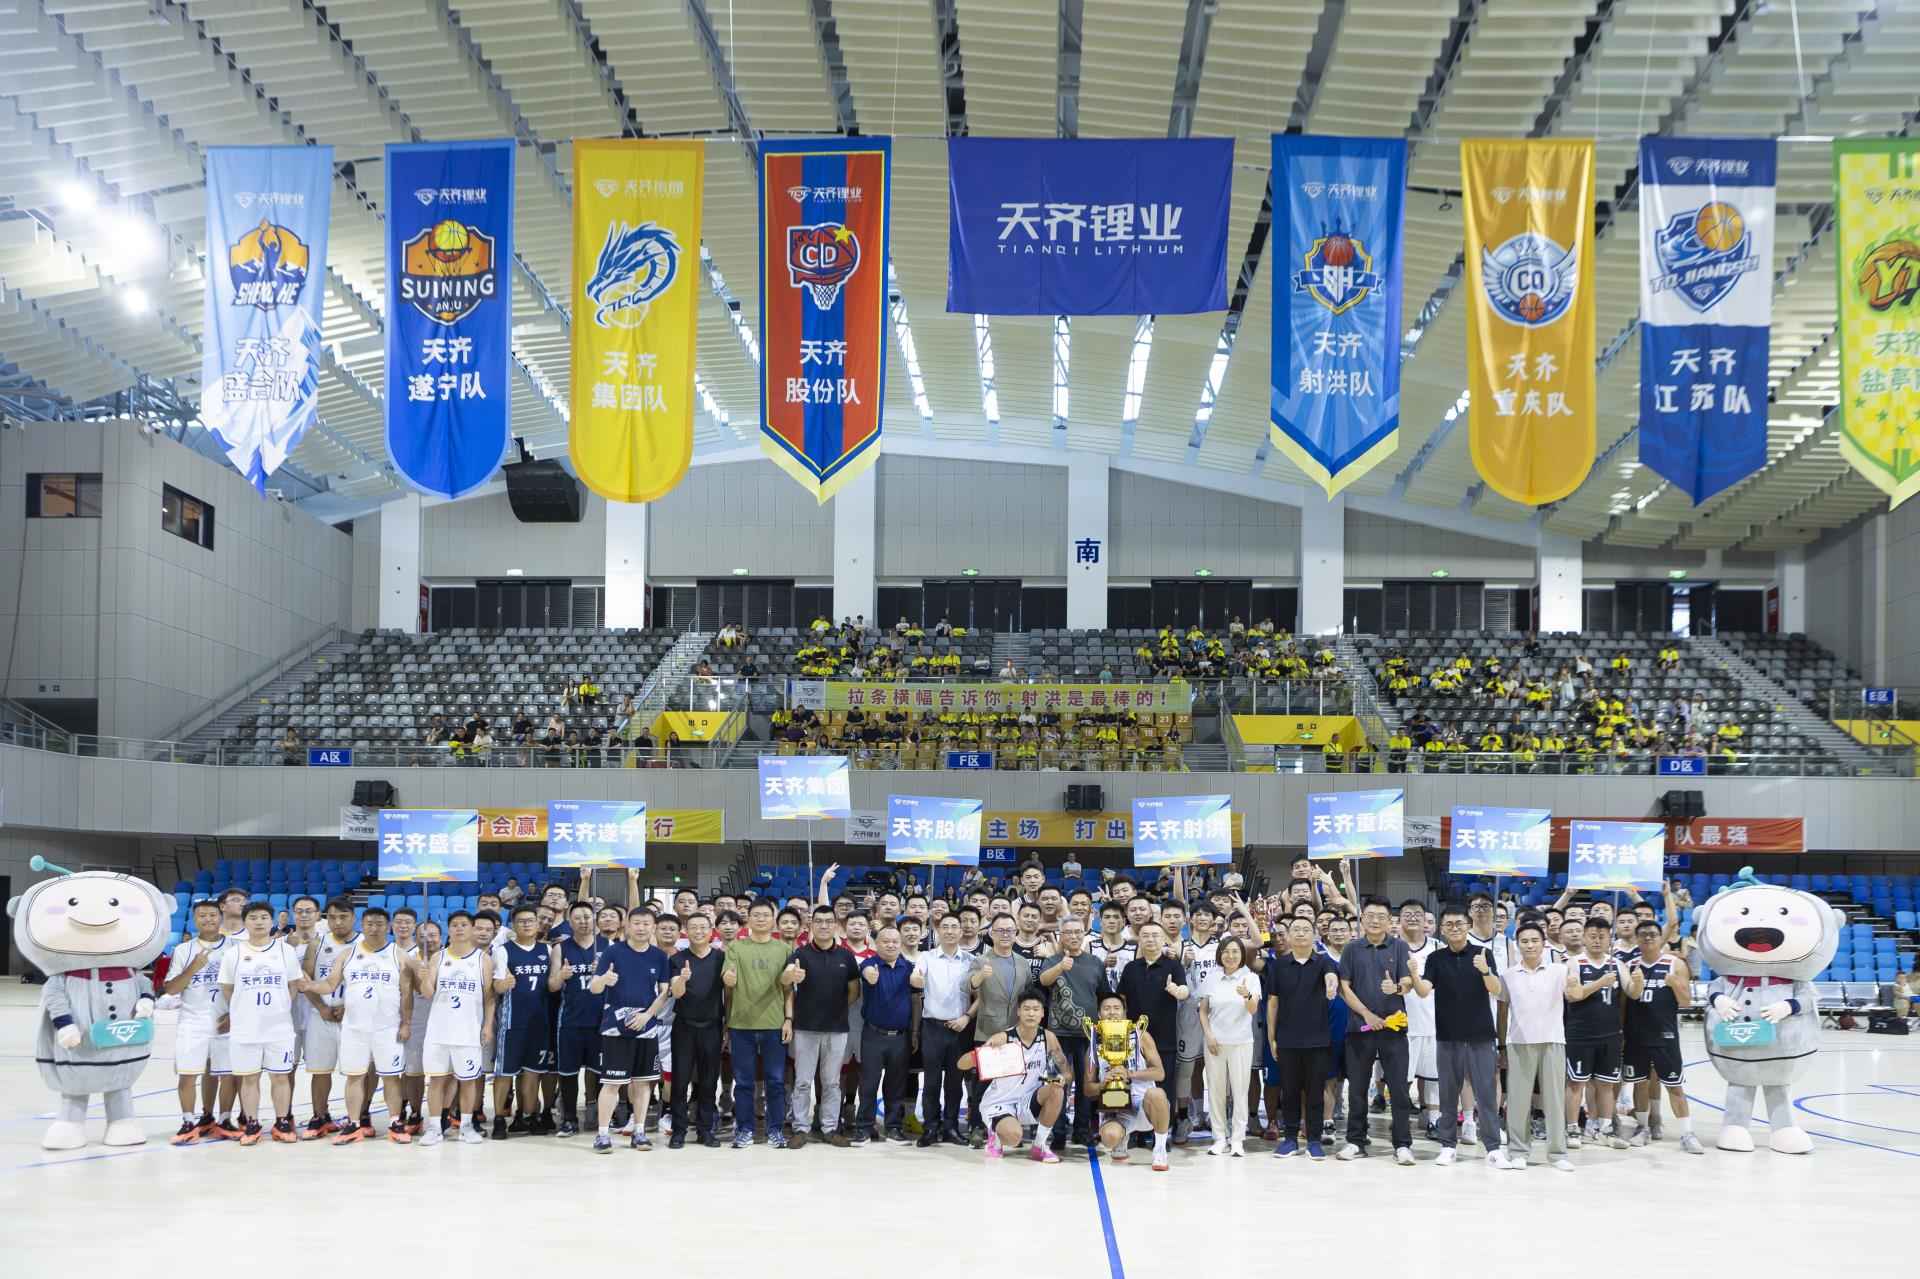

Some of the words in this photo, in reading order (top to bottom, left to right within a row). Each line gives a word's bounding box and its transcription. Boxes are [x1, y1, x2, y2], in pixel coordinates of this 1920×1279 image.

[996, 202, 1183, 242] 天齐锂业
[800, 243, 839, 267] CD
[997, 244, 1077, 256] TIANQI
[1095, 244, 1183, 256] LITHIUM
[236, 282, 276, 305] SHENG
[277, 281, 300, 304] HE
[401, 274, 494, 300] SUINING
[436, 301, 462, 313] ANJU
[234, 337, 290, 368] 天齐
[422, 337, 473, 365] 天齐
[800, 339, 848, 366] 天齐
[1313, 331, 1363, 358] 天齐
[602, 350, 658, 380] 天齐
[1506, 352, 1560, 382] 天齐
[1669, 347, 1737, 376] 天齐
[408, 371, 487, 402] 遂宁队
[785, 377, 861, 406] 股份队
[1299, 367, 1375, 398] 射洪队
[591, 381, 668, 413] 集团队
[1492, 388, 1575, 418] 重庆队
[1654, 383, 1753, 415] 江苏队
[1074, 537, 1101, 564] 南
[1159, 715, 1169, 723] 21
[1178, 715, 1188, 723] 22
[319, 751, 341, 762] A区
[959, 754, 980, 767] F区
[1669, 759, 1694, 772] D区
[764, 776, 846, 797] 天齐集团
[552, 821, 643, 844] 天齐遂宁
[891, 816, 977, 841] 天齐股份
[988, 819, 1040, 840] 主场
[1075, 819, 1126, 840] 打出
[1138, 818, 1226, 841] 天齐射洪
[1312, 811, 1399, 835] 天齐重庆
[383, 832, 472, 855] 天齐盛合
[1456, 828, 1546, 852] 天齐江苏
[1664, 825, 1748, 847] 队最强
[986, 848, 1006, 860] B区
[515, 965, 548, 974] 天齐遂宁
[529, 975, 538, 991] 7
[209, 988, 220, 1003] 7
[256, 991, 272, 1005] 10
[451, 996, 462, 1009] 3
[537, 1049, 547, 1065] 7
[1178, 1039, 1186, 1052] 9
[466, 1059, 475, 1071] 3
[1575, 1060, 1582, 1073] 1
